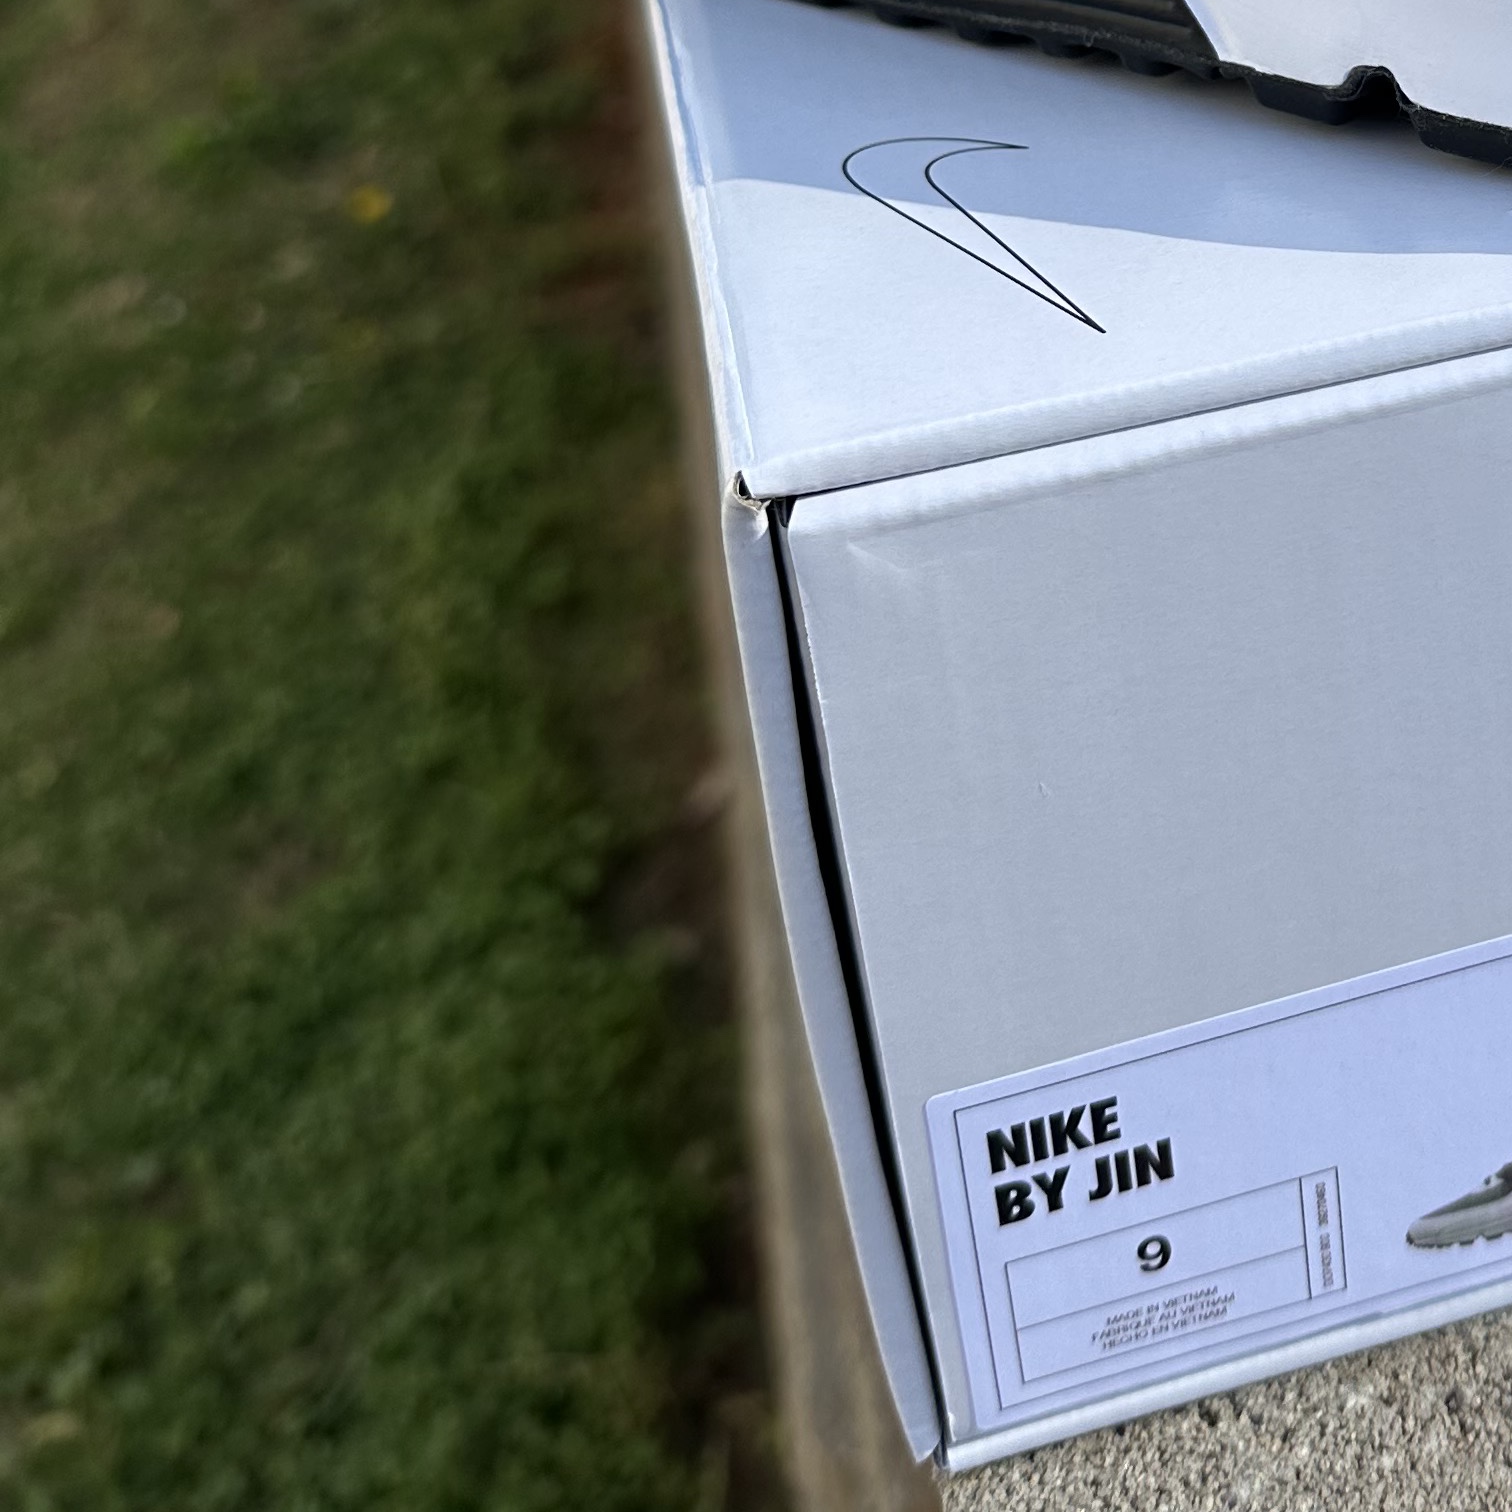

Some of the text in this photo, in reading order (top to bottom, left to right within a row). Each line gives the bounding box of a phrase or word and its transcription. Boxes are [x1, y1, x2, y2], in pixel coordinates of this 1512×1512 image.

[986, 1095, 1122, 1174] NIKE
[994, 1136, 1175, 1227] BY JIN
[1136, 1234, 1172, 1272] 9
[1106, 1285, 1219, 1326] MADE IN VIETNAM
[1172, 1306, 1228, 1330] VIETNAM
[1180, 1291, 1236, 1315] VIETNAM
